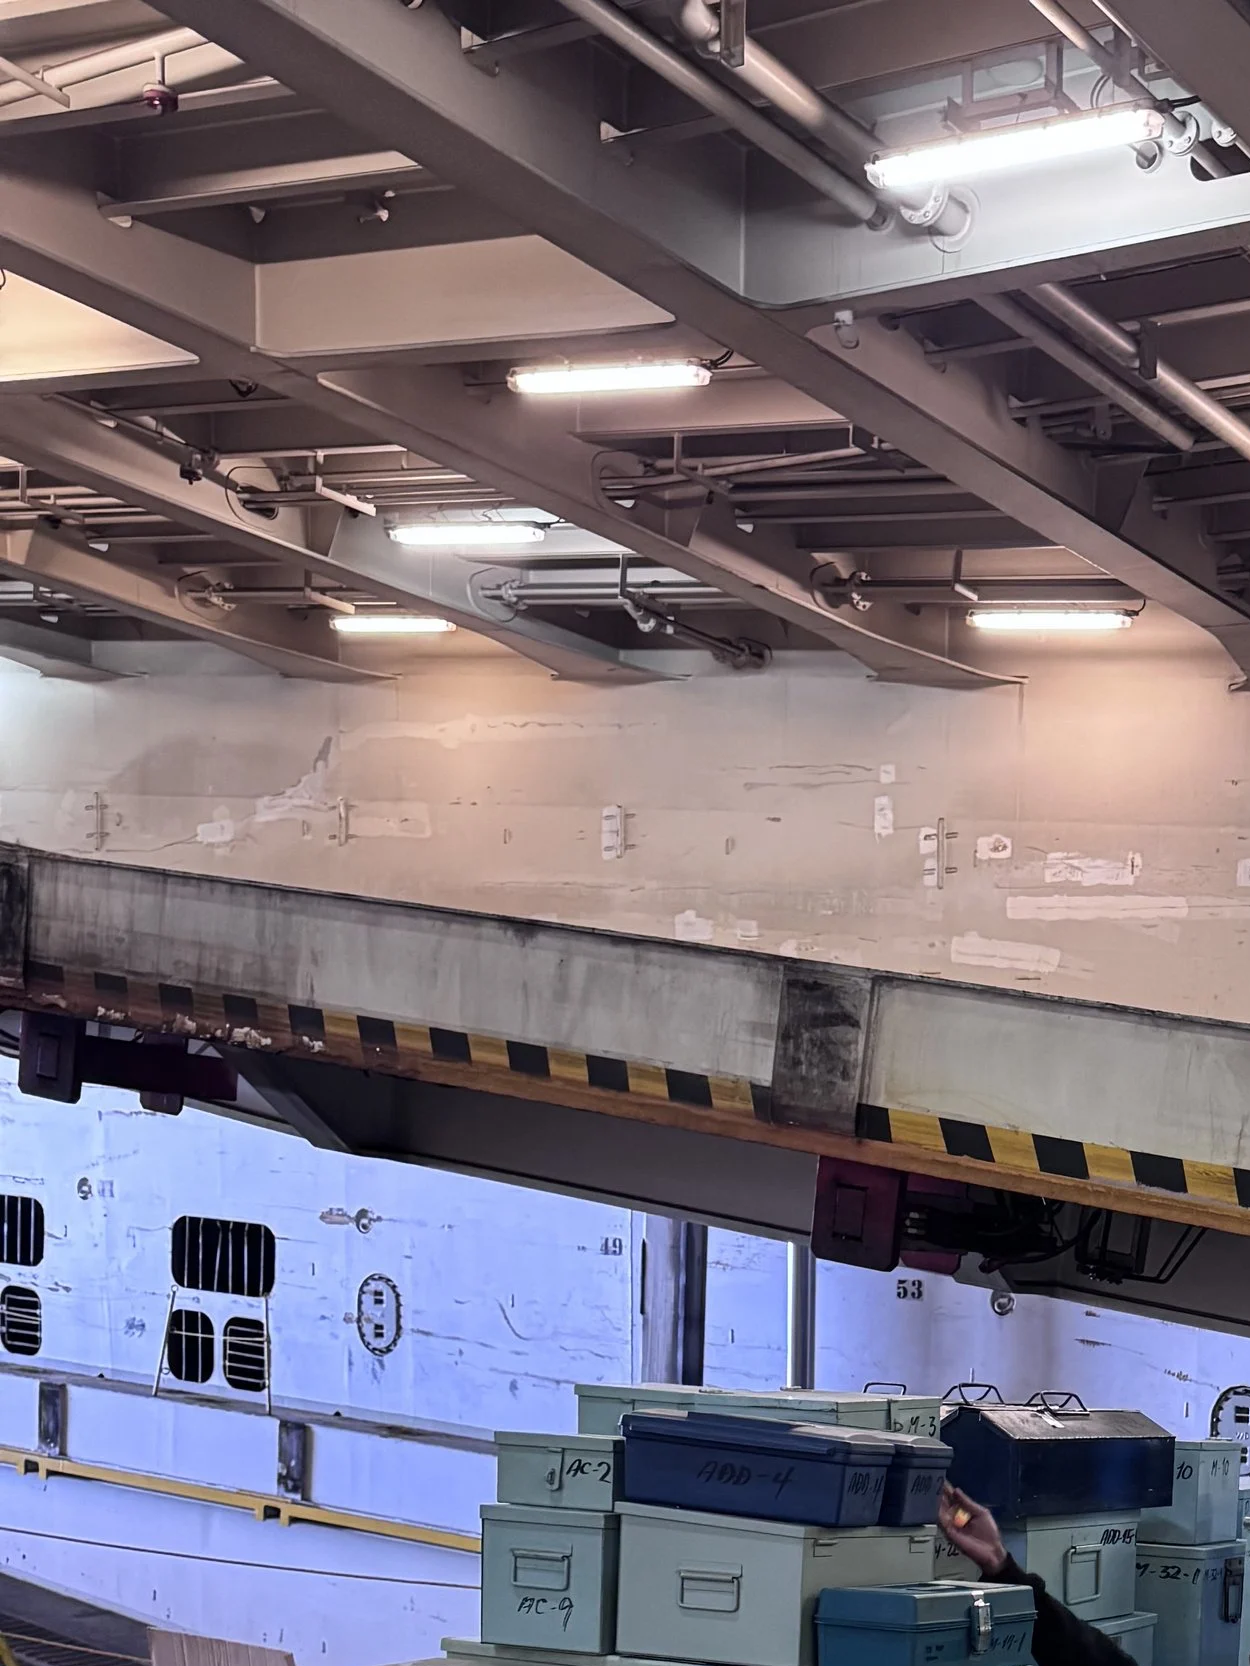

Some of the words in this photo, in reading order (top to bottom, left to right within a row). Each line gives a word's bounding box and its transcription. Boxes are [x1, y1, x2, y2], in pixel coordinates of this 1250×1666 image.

[599, 1236, 623, 1256] 49
[896, 1279, 923, 1299] 53
[566, 1458, 612, 1484] AC-2
[1210, 1457, 1230, 1476] M-10
[696, 1459, 796, 1499] ADD-4
[517, 1596, 575, 1633] AC-9
